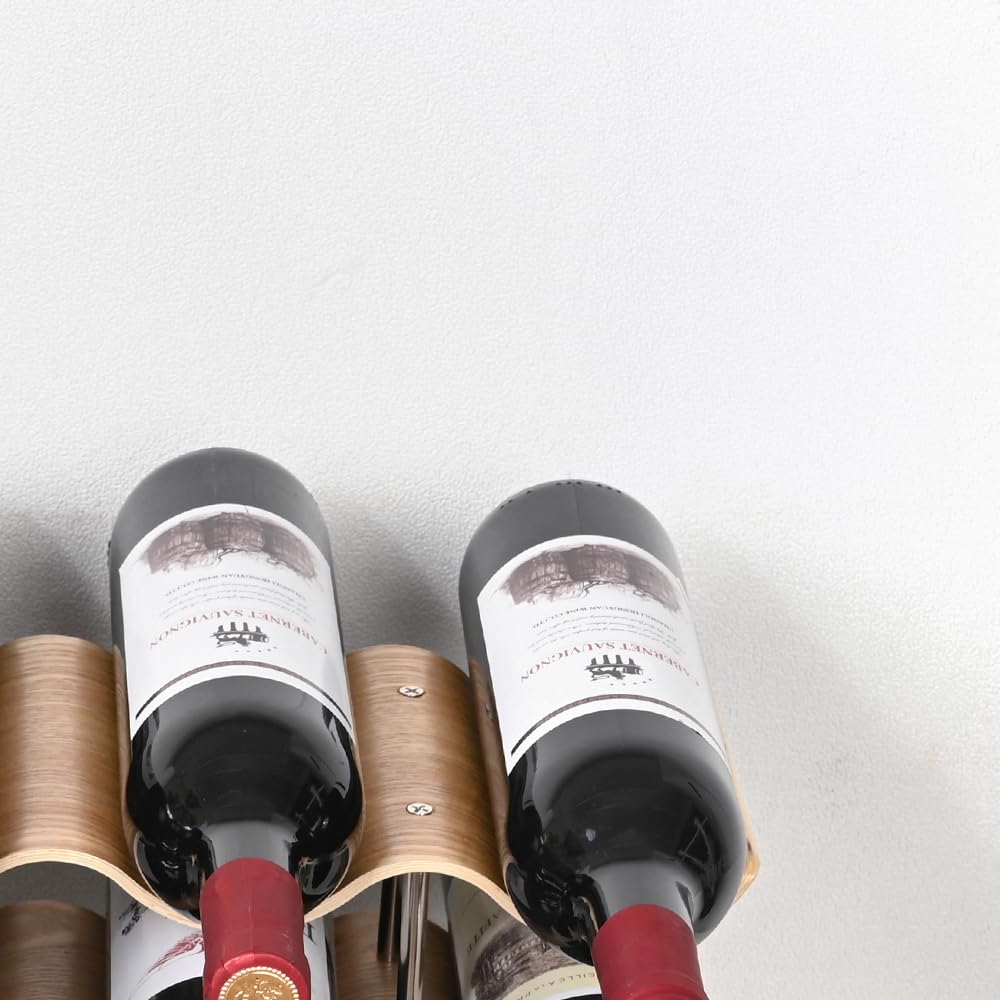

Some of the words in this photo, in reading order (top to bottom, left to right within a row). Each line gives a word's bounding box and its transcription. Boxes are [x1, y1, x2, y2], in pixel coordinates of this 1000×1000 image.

[150, 610, 244, 650] SAUVIGNON
[250, 610, 328, 656] CABERNET
[520, 642, 616, 683] SAUVIGNON
[619, 642, 700, 687] CABERNET
